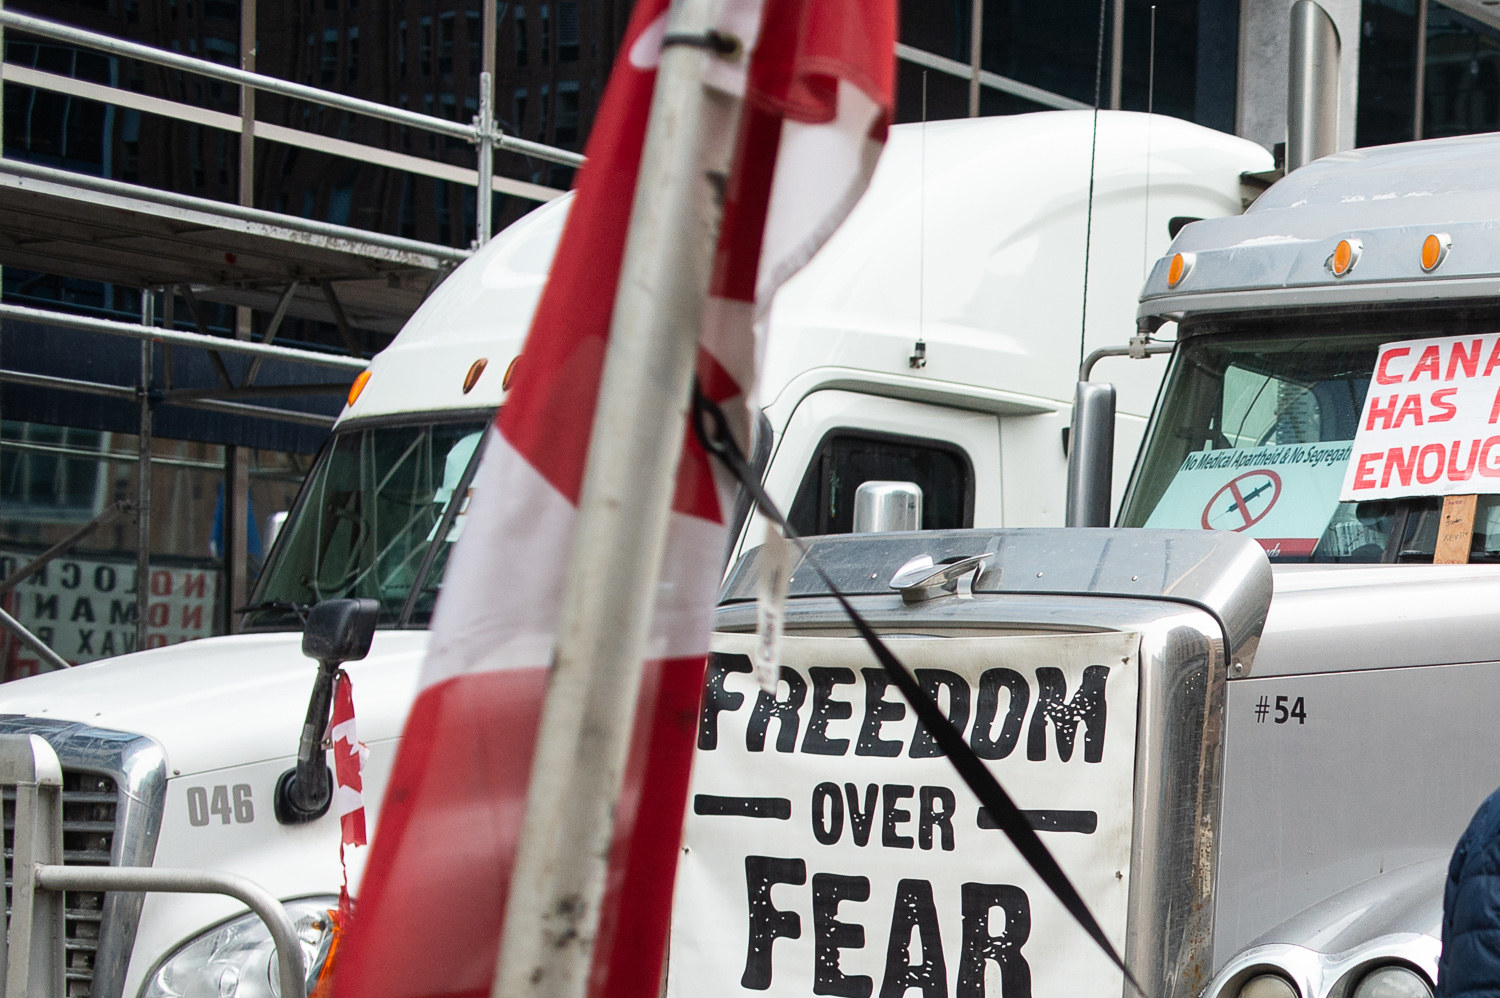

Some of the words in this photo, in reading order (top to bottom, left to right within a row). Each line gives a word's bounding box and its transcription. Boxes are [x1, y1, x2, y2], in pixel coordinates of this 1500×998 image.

[1365, 387, 1458, 431] HAS
[1181, 454, 1197, 471] No
[1199, 451, 1233, 470] Medical
[1232, 449, 1280, 470] Apartheid
[1280, 450, 1290, 465] &
[1290, 447, 1301, 463] No
[696, 653, 1111, 764] FREEDOM
[1255, 695, 1307, 725] #54
[186, 784, 255, 827] 046
[811, 782, 957, 851] OVER
